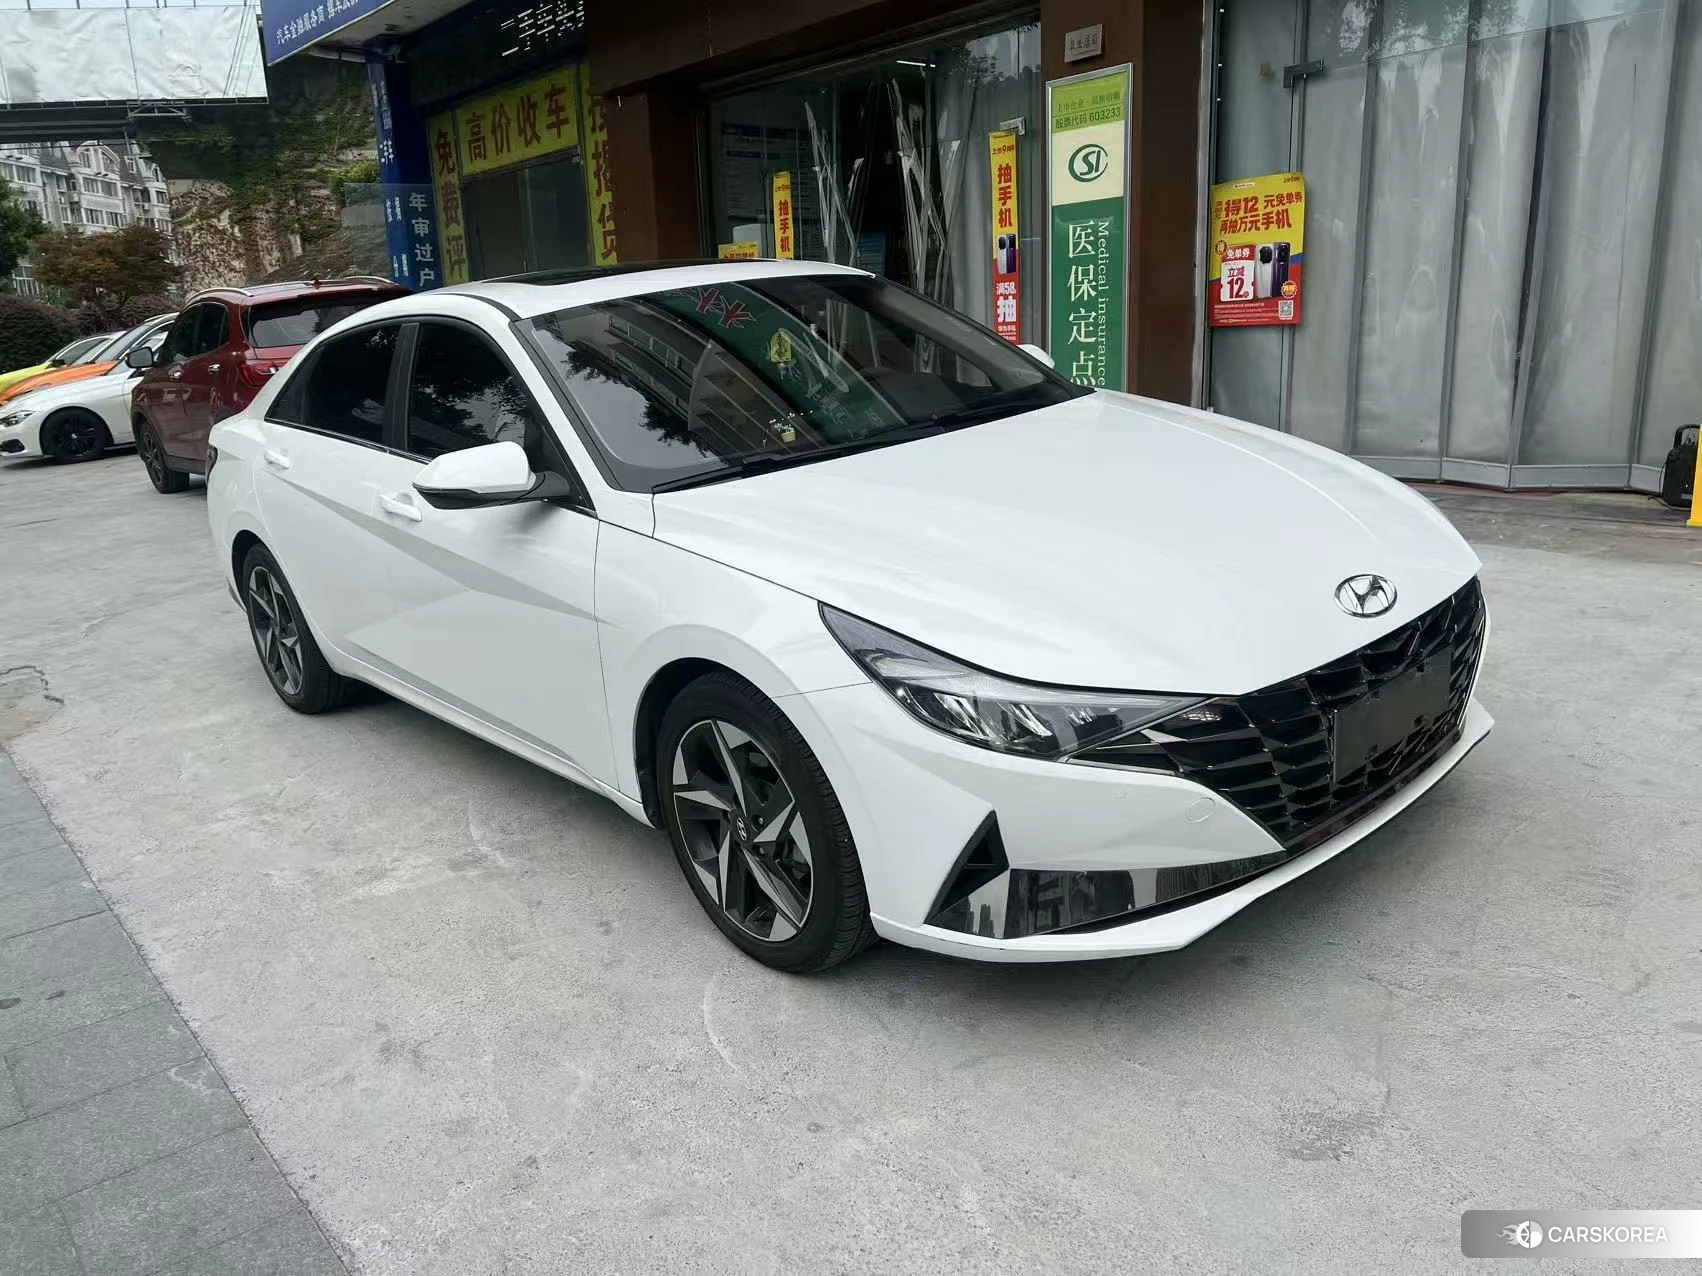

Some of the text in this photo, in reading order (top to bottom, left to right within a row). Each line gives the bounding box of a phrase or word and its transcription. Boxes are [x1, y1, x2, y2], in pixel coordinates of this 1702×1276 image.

[465, 84, 570, 163] 高价收车
[1055, 106, 1121, 129] 股票代码 603233
[997, 163, 1013, 228] 抽手机
[1219, 208, 1292, 235] 再抽万元手机
[408, 192, 435, 287] 年审过户
[778, 199, 790, 252] 抽手机
[1228, 266, 1245, 277] 立减
[997, 295, 1017, 323] 抽
[1067, 220, 1097, 386] 医保定点
[1098, 222, 1109, 386] Medical insurance
